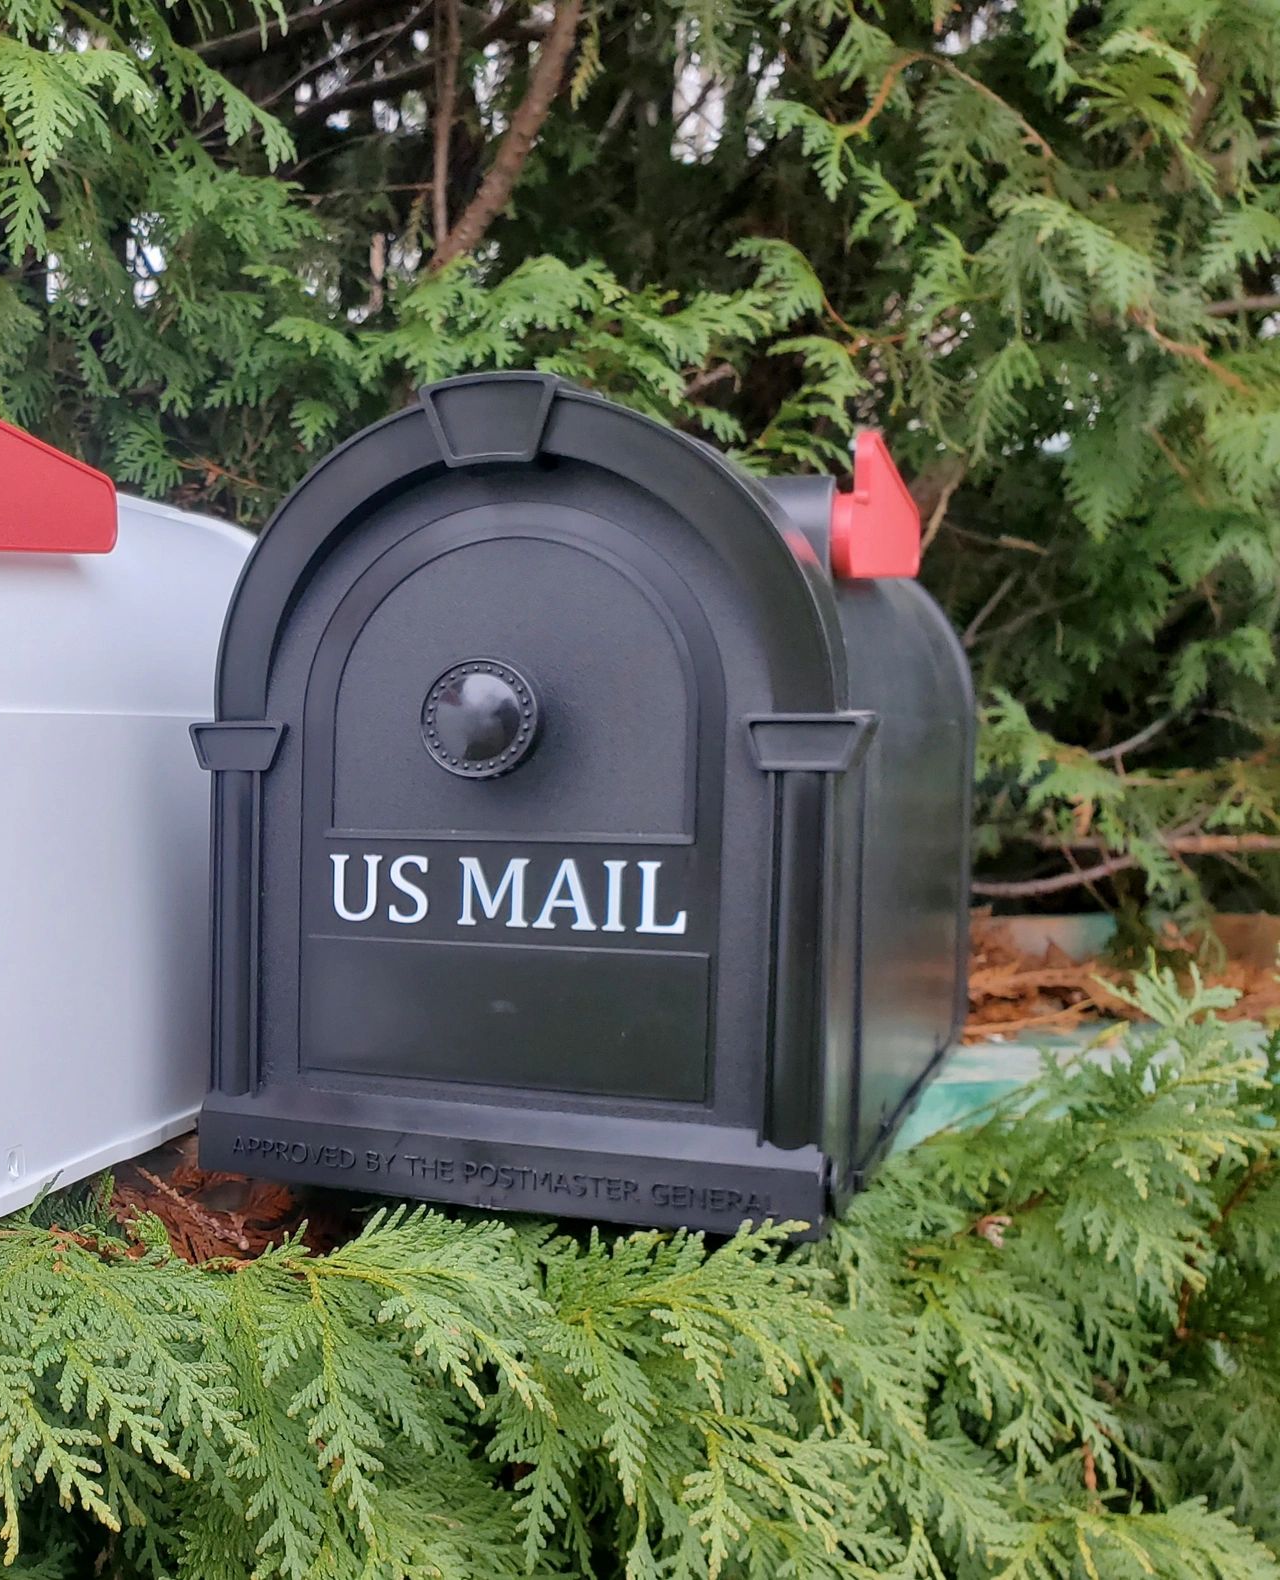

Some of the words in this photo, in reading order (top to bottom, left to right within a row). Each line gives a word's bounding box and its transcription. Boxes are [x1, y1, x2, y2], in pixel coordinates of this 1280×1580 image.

[329, 853, 430, 925] US
[456, 856, 688, 936] MAIL
[232, 1135, 357, 1170] APPROVED
[365, 1150, 397, 1174] BY
[403, 1154, 455, 1183] THE
[463, 1160, 641, 1203] POSTMASTER
[651, 1182, 781, 1220] GENERAL
